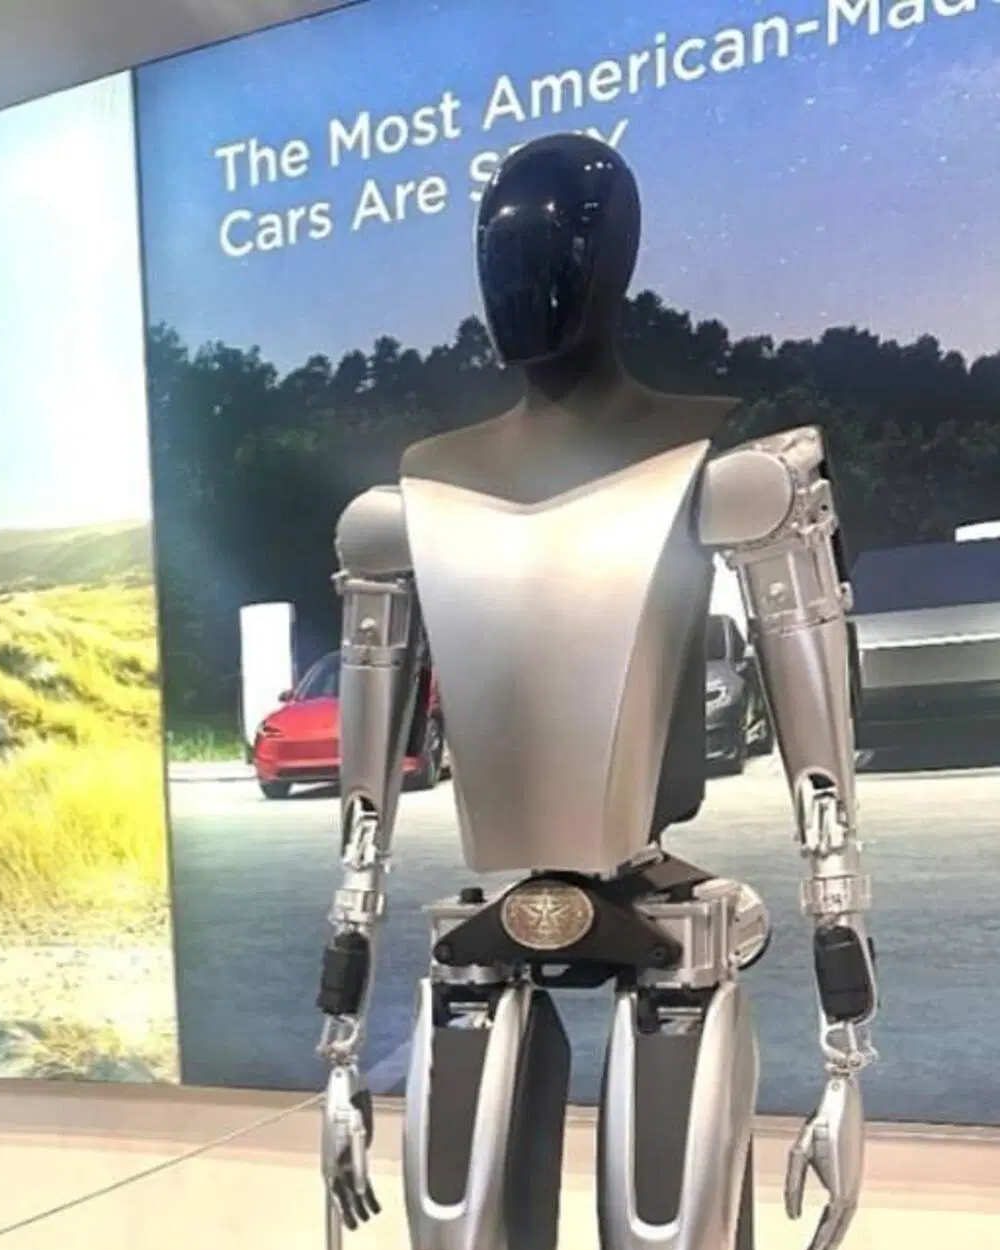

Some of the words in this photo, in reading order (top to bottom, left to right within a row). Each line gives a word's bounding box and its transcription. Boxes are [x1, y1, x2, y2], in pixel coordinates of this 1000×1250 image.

[215, 139, 310, 190] The
[329, 93, 462, 166] Most
[218, 203, 332, 257] Cars
[352, 176, 448, 231] Are
